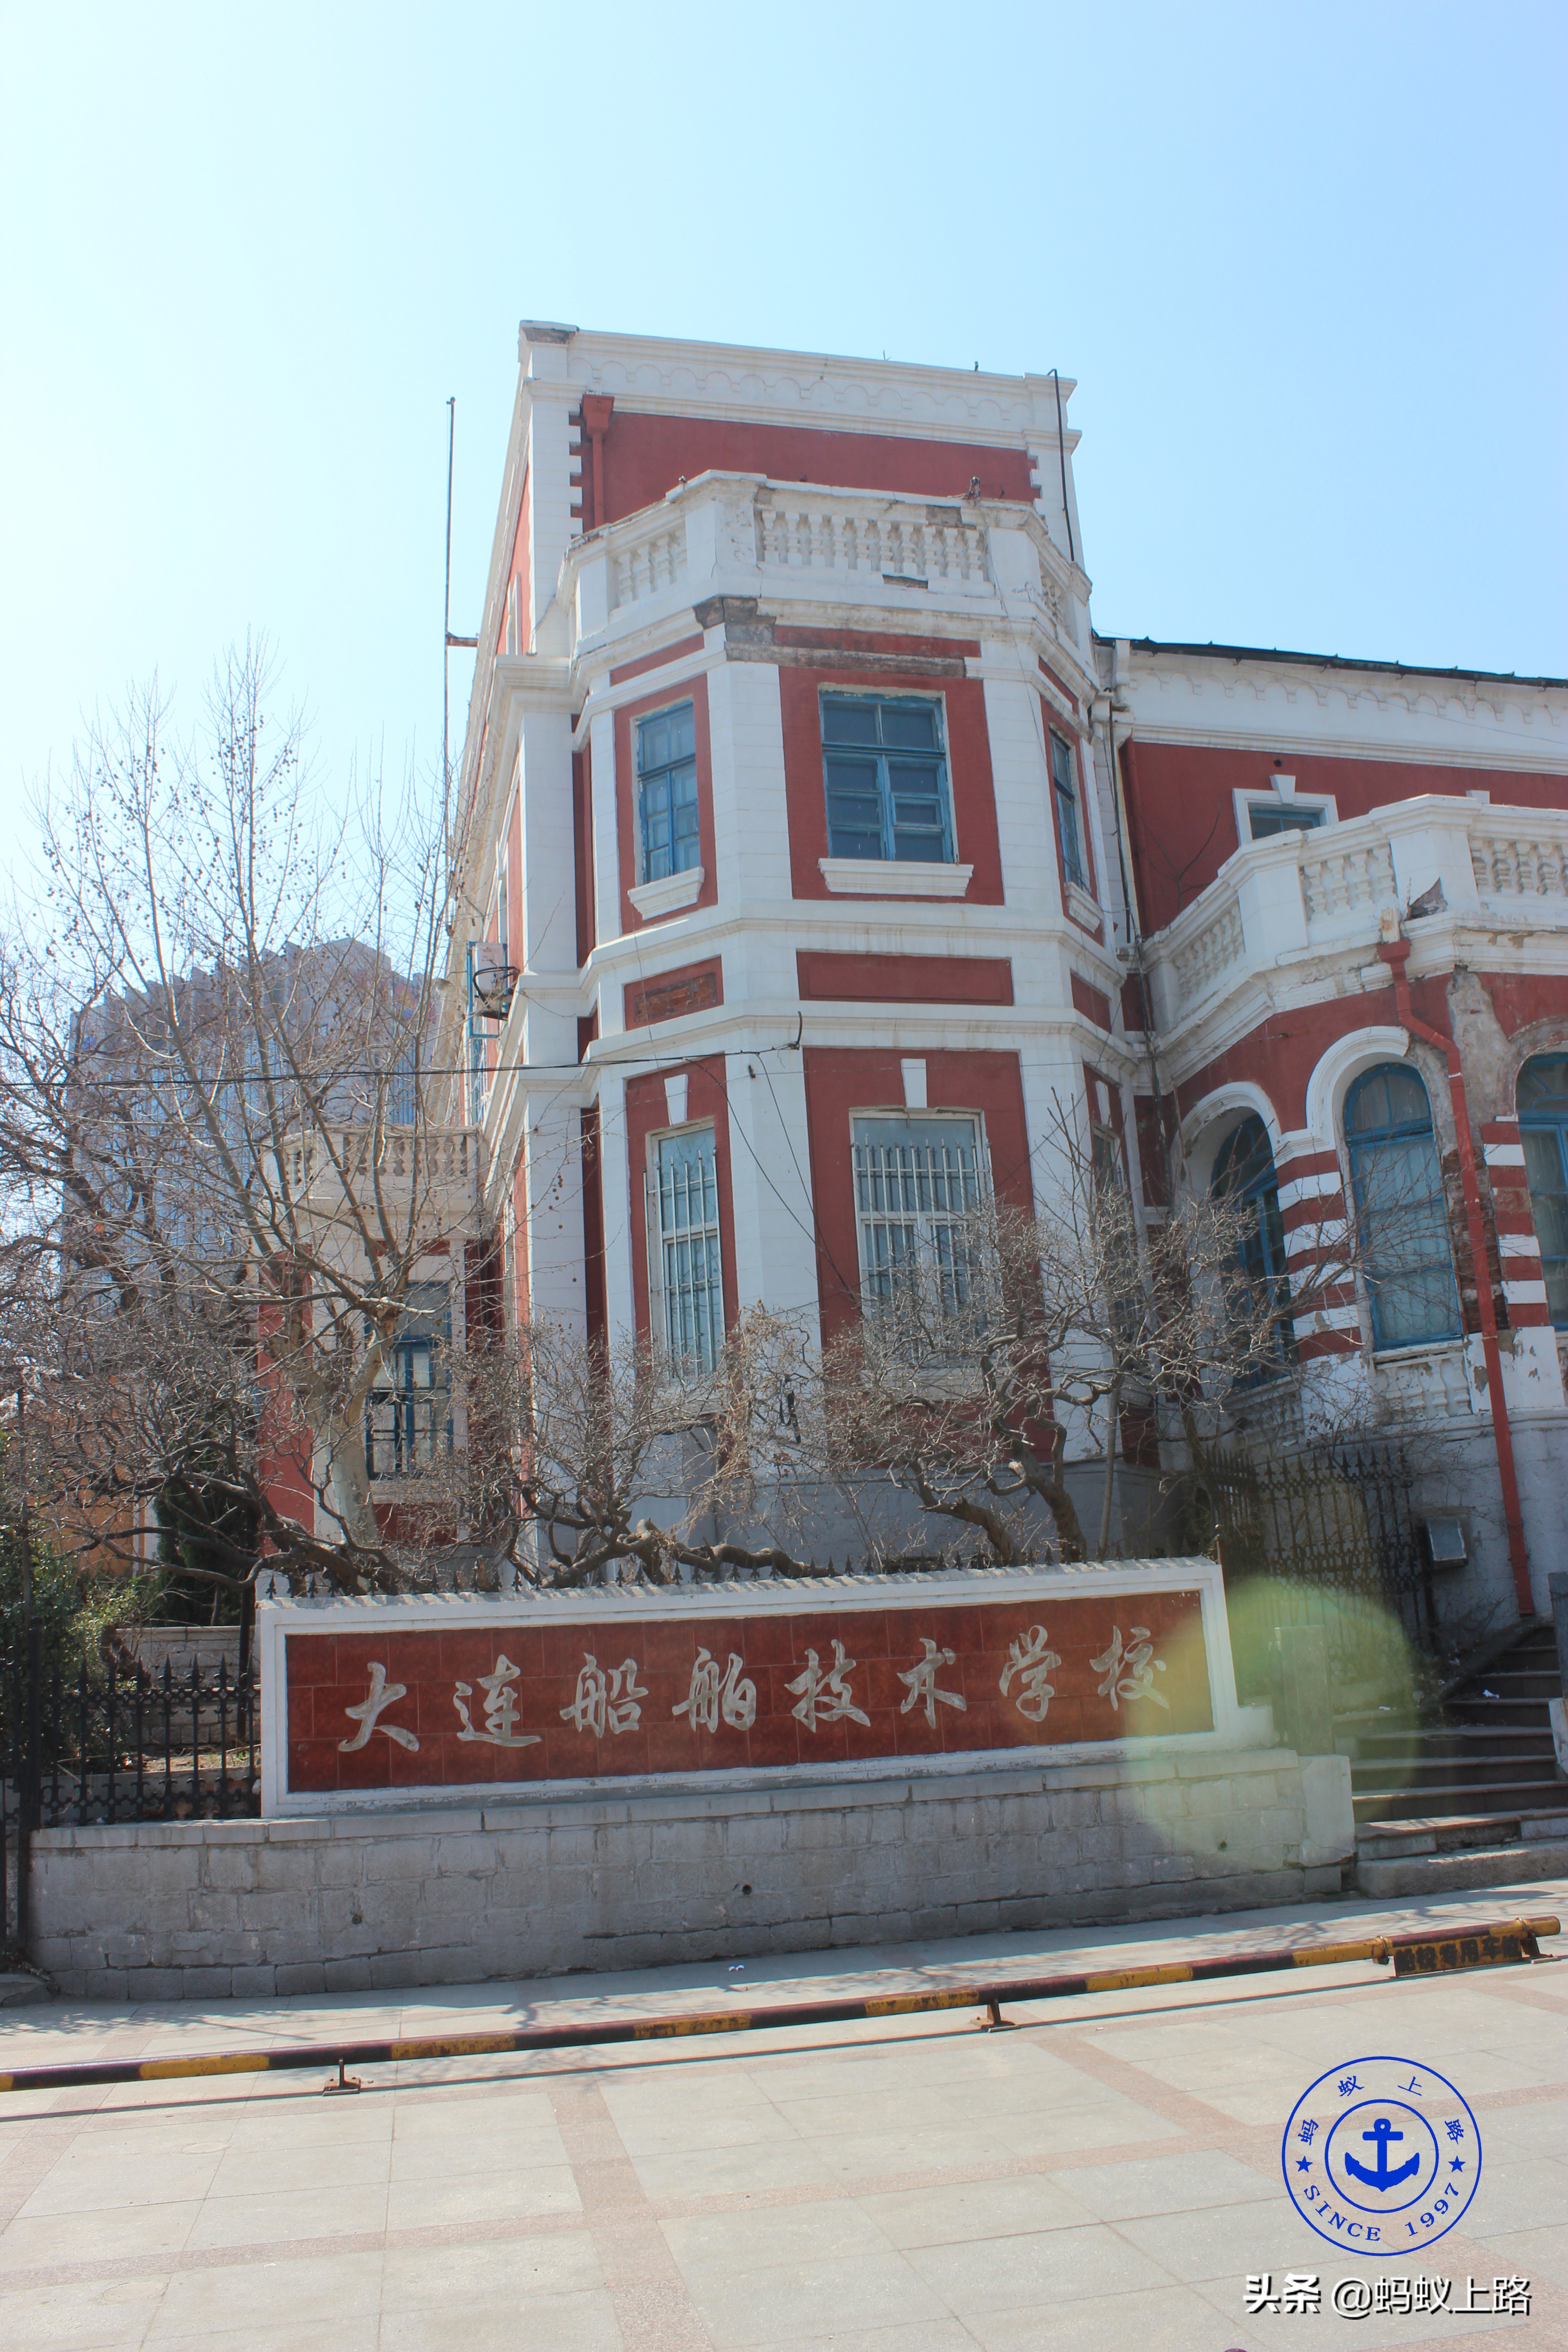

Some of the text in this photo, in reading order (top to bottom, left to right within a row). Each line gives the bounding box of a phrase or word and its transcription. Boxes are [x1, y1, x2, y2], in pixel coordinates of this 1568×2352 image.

[337, 1625, 1169, 1753] 大连船舶技术学校
